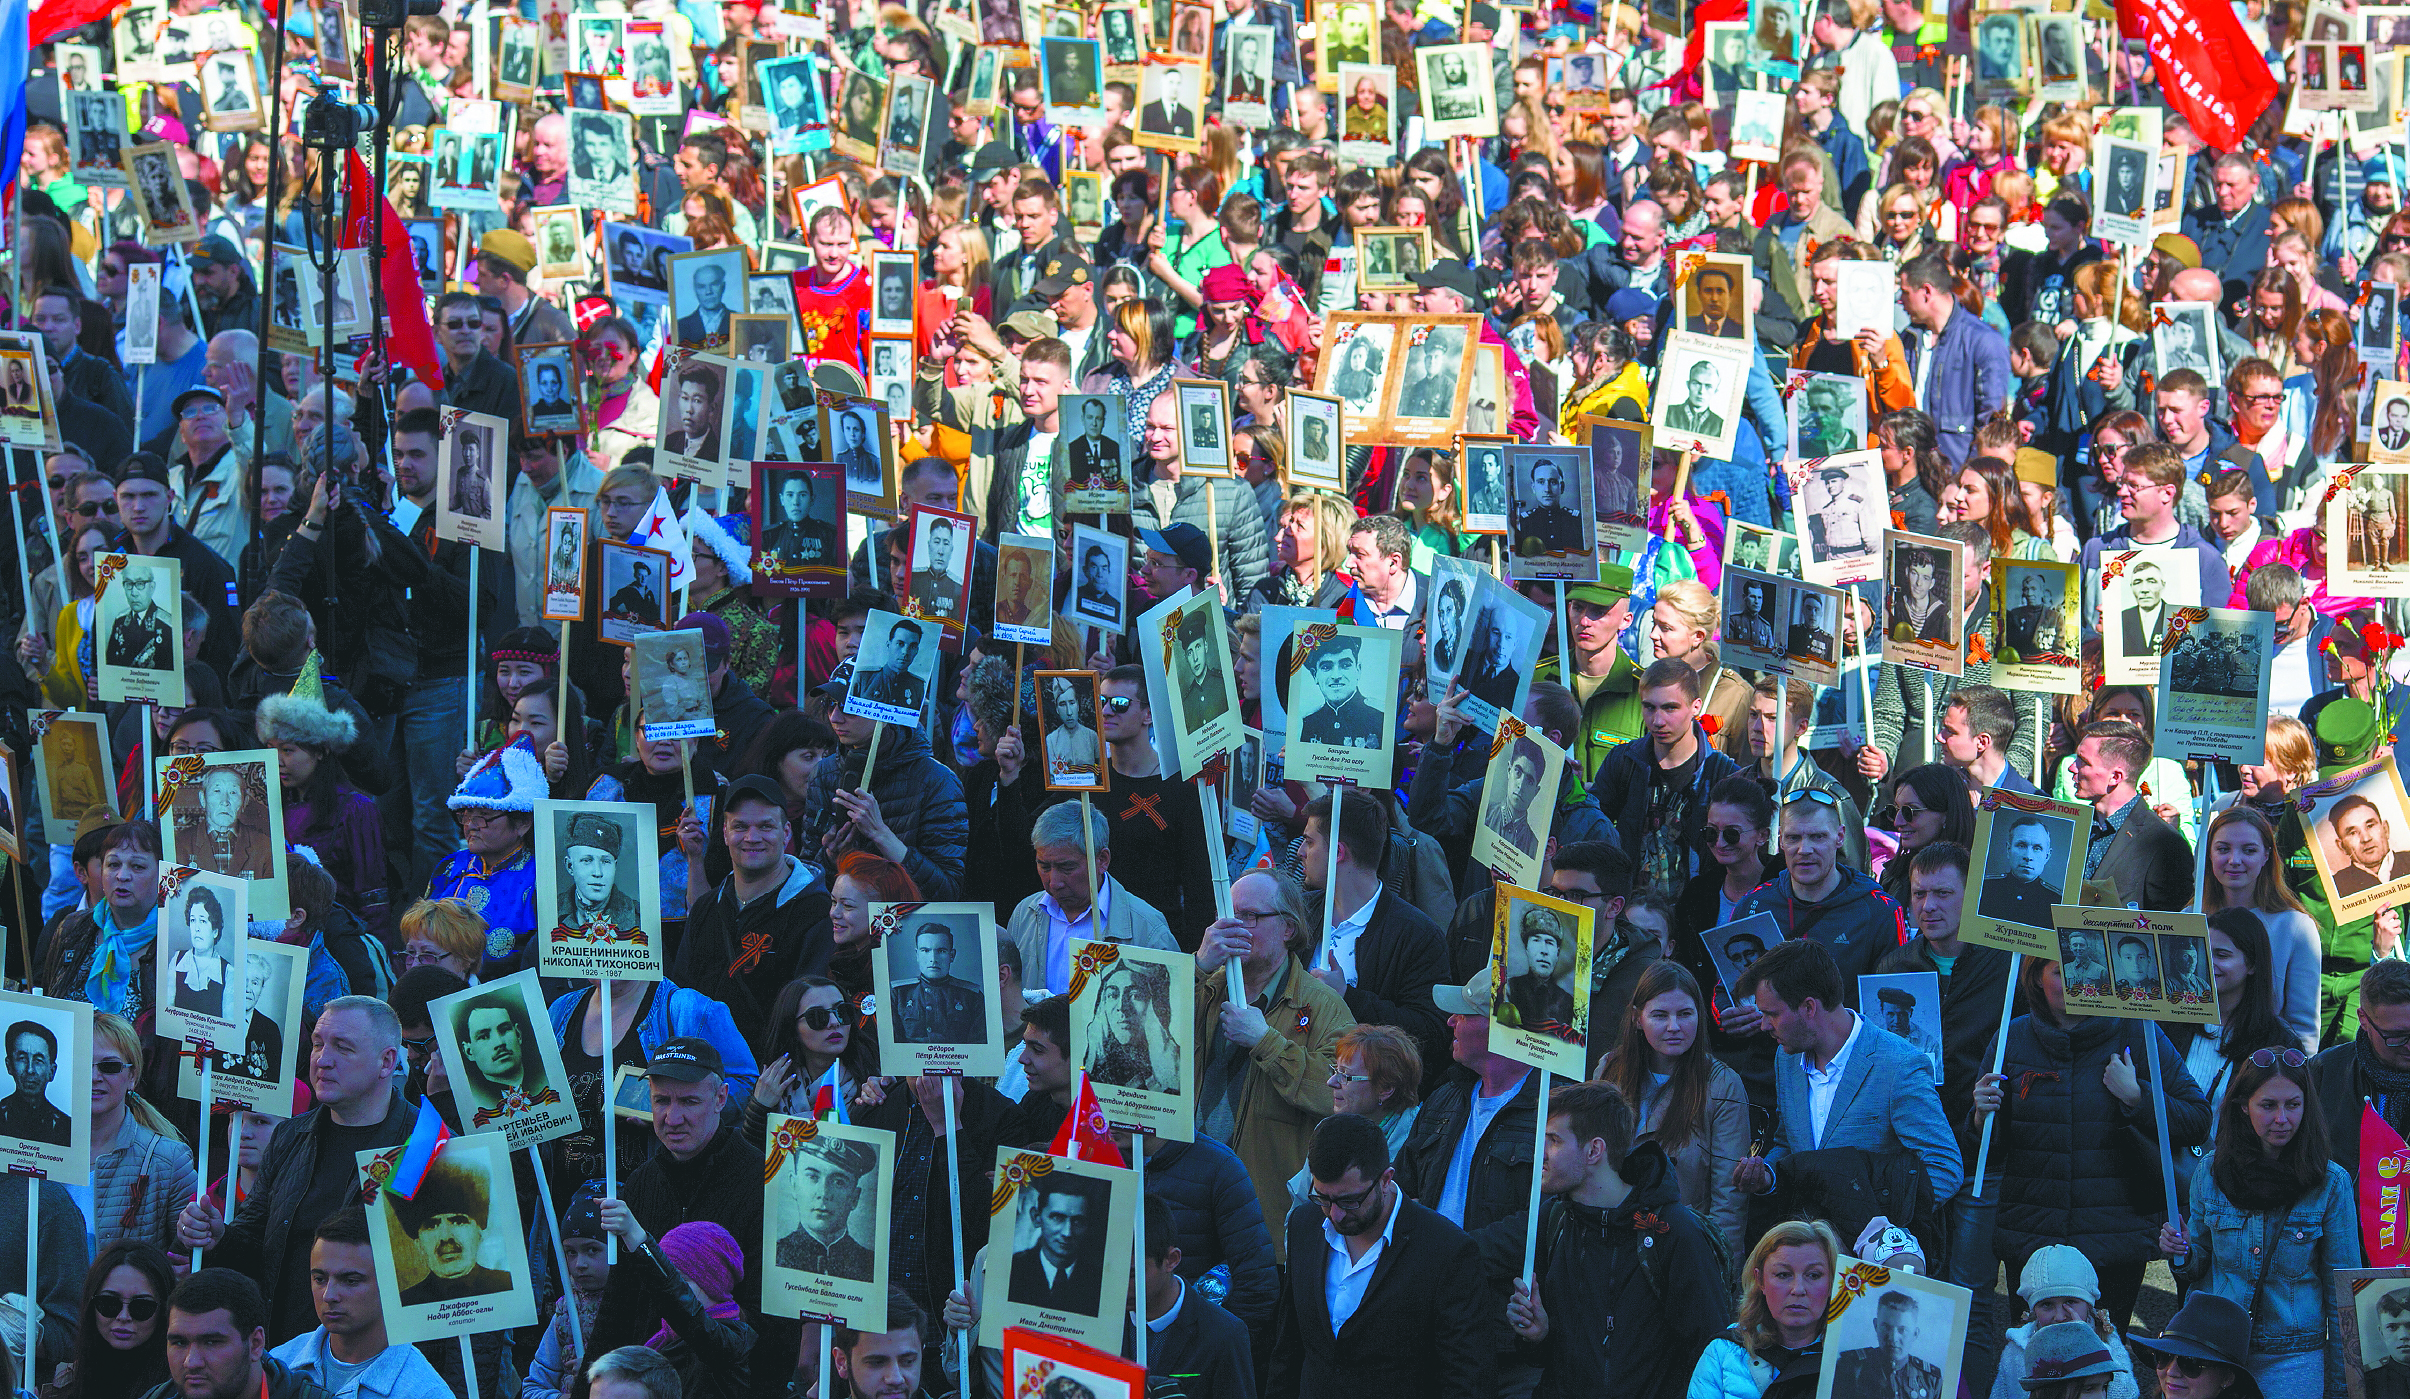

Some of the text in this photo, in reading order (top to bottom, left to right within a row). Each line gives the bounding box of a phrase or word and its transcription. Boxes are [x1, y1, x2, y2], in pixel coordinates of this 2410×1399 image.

[2174, 728, 2197, 736] Косарев
[2184, 740, 2217, 748] Пулковских
[2206, 736, 2229, 744] Победы
[2361, 762, 2384, 776] ПОЛК
[2057, 803, 2081, 816] ПОЛК
[2341, 899, 2367, 911] Аникин
[2367, 887, 2395, 902] Николай
[1995, 924, 2037, 940] Журавлев
[1983, 932, 2048, 951] Владимир Иванович
[551, 946, 650, 959] КРАШЕНИННИКОВ
[543, 955, 660, 971] НИКОЛАЙ ТИХОНОВИЧ
[581, 969, 597, 977] 1926
[605, 970, 623, 978] 1987
[927, 1044, 955, 1054] Фёдоров
[1515, 1038, 1559, 1058] Иван Григорьевич
[915, 1052, 969, 1061] Пётр Алексеевич
[223, 1074, 245, 1086] Андрей
[1116, 1089, 1147, 1100] Эфендиев
[1123, 1100, 1162, 1112] Абдурахман
[1162, 1107, 1177, 1116] оглу
[498, 1112, 552, 1132] АРТЕМЬЕВ
[520, 1114, 573, 1138] ИВАНОВИЧ
[18, 1141, 41, 1152] Орехов
[510, 1134, 545, 1150] 1903-1943
[0, 1146, 64, 1164] онстантин Павлович
[814, 1277, 834, 1287] Алиев
[784, 1282, 819, 1295] Гусейнбала
[847, 1294, 864, 1303] оглы
[439, 1300, 479, 1313] Джафаров
[427, 1306, 494, 1322] Надир Аббас-оглы
[1039, 1311, 1066, 1323] Климов
[448, 1317, 476, 1328] капитан
[1019, 1317, 1085, 1335] Иван Дмитриевич
